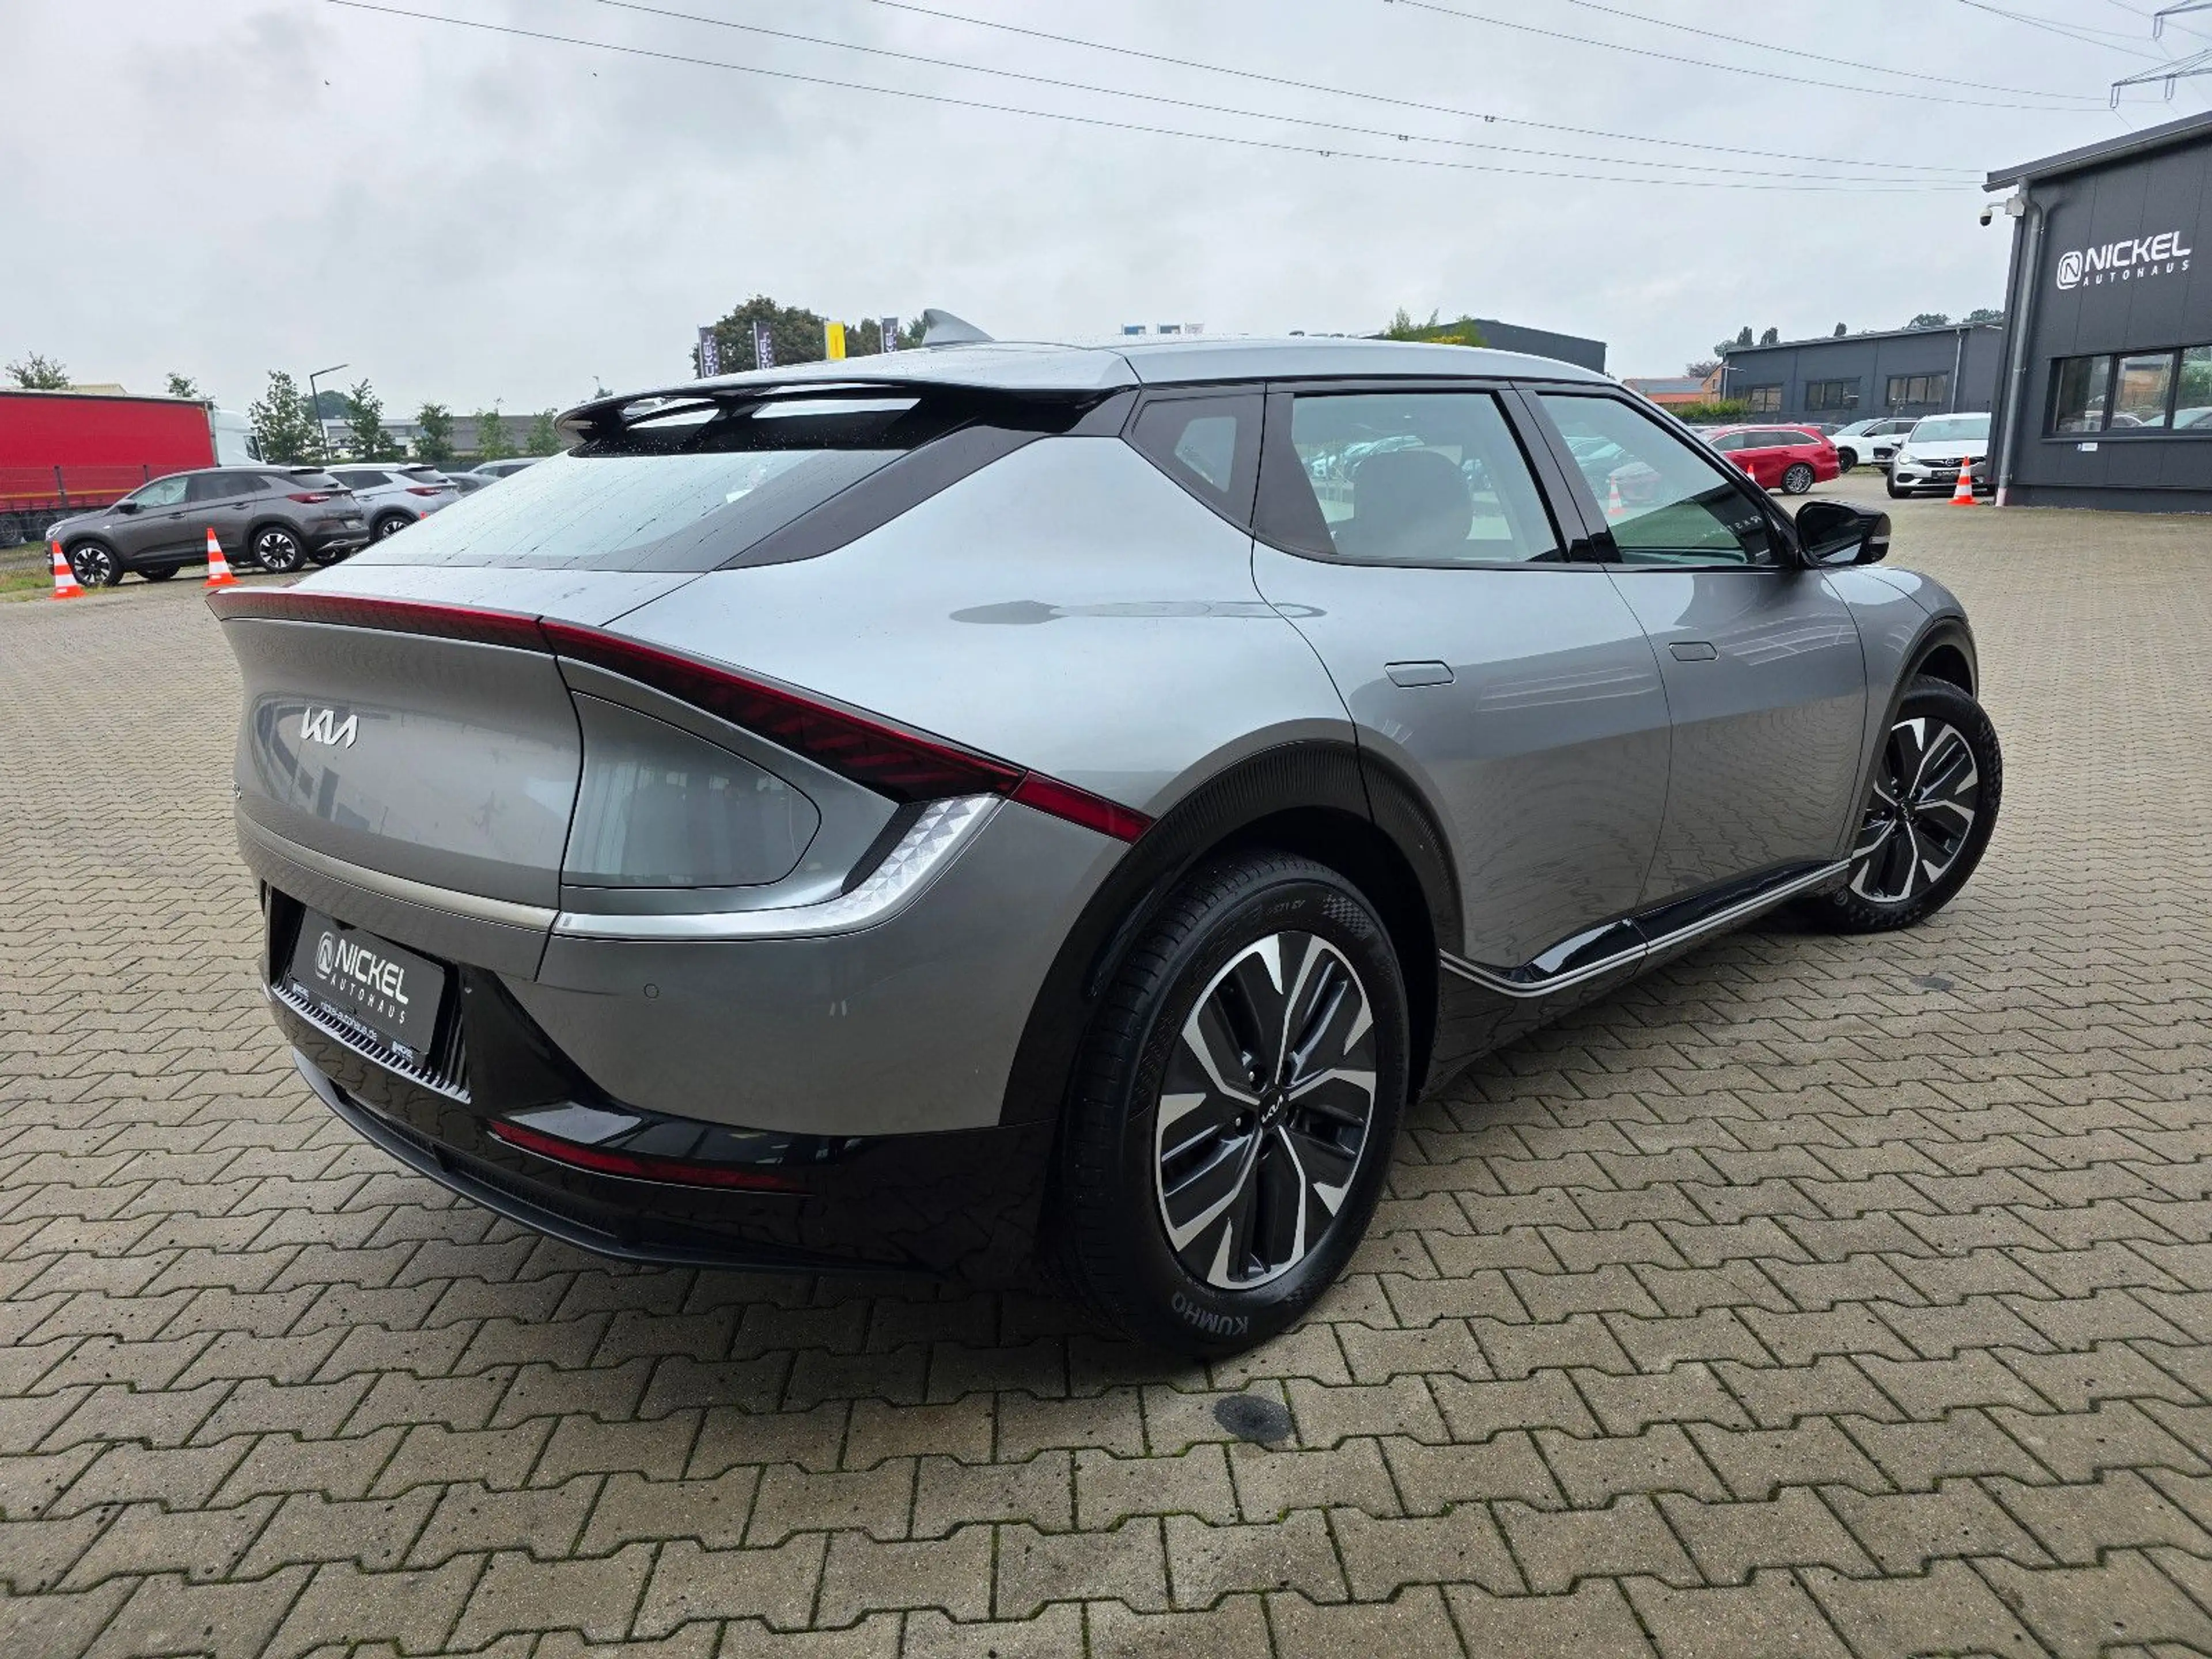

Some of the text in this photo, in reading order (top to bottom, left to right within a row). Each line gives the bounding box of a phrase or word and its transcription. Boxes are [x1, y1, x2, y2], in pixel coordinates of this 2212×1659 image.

[2083, 260, 2190, 286] AUTOHAUS
[2085, 231, 2191, 272] NICKEL
[703, 334, 714, 377] CKEL
[300, 707, 359, 748] KIA
[335, 938, 408, 1004] NICKEL
[330, 974, 406, 1024] AUTOHAUS
[1171, 1291, 1249, 1336] KUMHO
